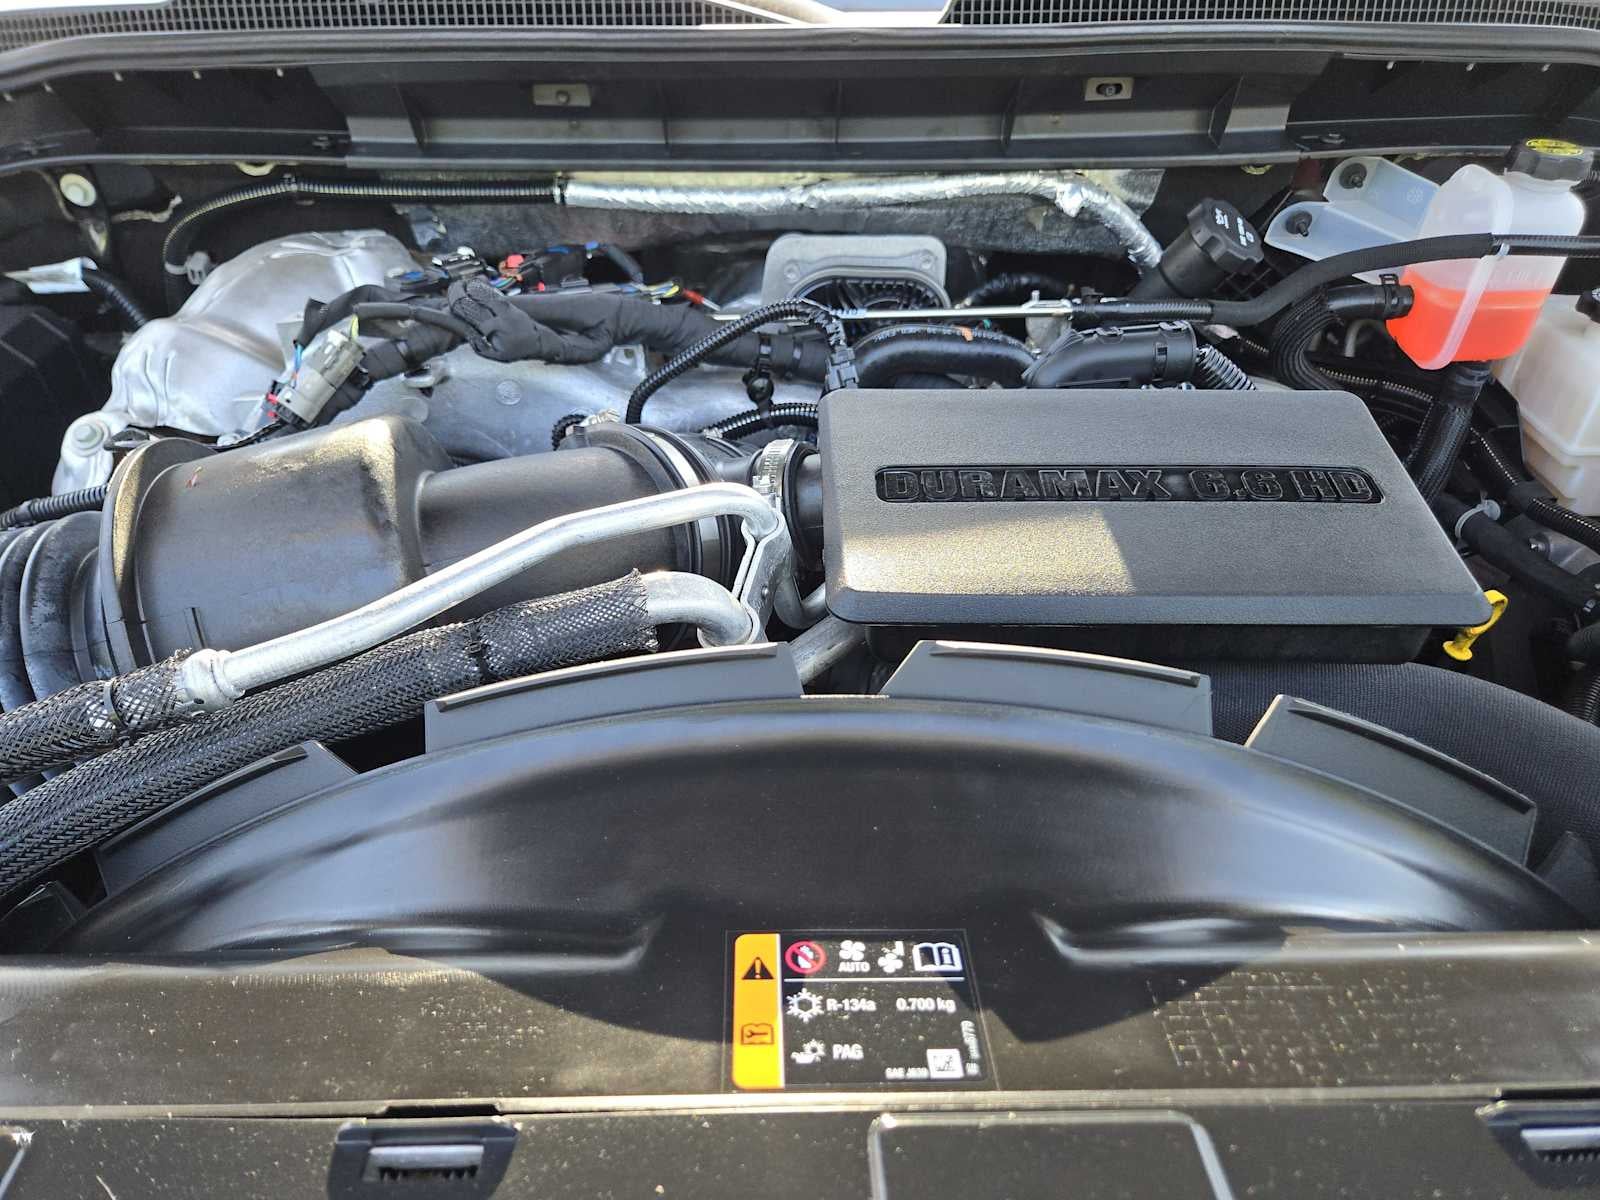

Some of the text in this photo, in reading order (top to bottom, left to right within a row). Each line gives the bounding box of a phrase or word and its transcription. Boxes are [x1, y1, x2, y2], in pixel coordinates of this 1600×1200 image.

[884, 470, 1373, 500] DURAMAX 6.6 HD
[838, 962, 870, 973] AUTO
[826, 998, 956, 1013] R-134a 0.700 kg
[832, 1044, 864, 1060] PAG
